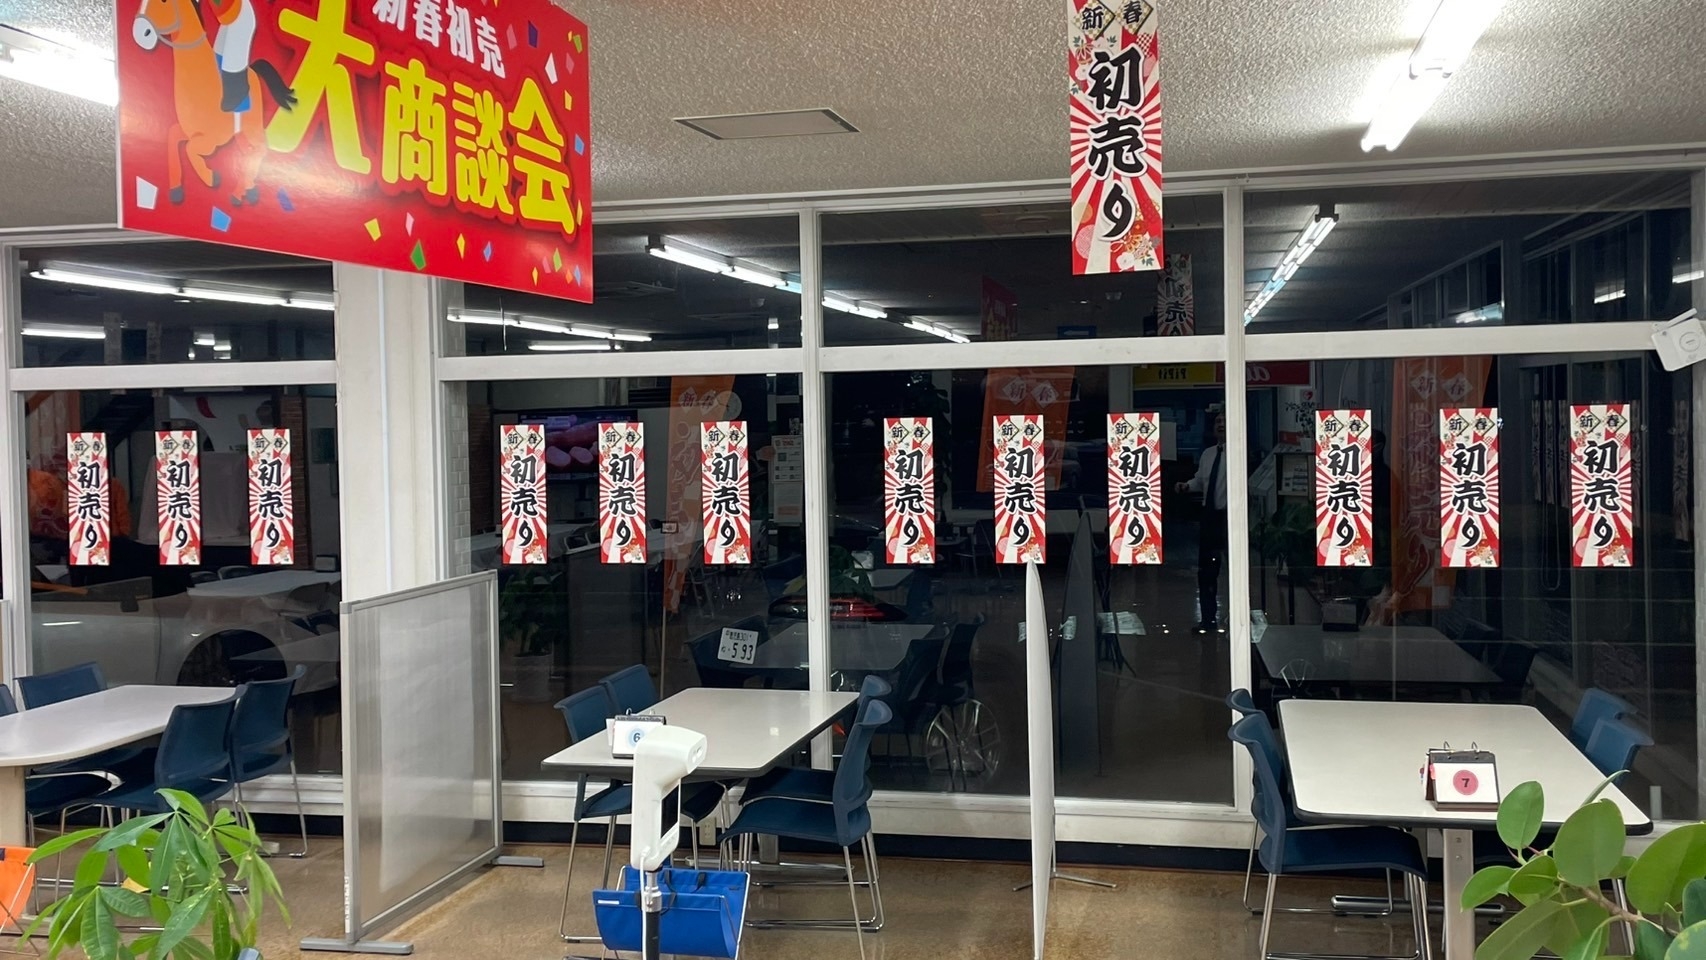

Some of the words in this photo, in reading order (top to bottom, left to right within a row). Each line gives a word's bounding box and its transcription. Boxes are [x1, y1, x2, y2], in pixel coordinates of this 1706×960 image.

[1081, 1, 1142, 30] 新春
[265, 0, 575, 235] 大商談会
[1088, 47, 1146, 238] 初売り
[605, 430, 636, 444] 新春
[708, 429, 740, 443] 新春
[892, 423, 925, 438] 新春
[1001, 425, 1036, 438] 新春
[1115, 422, 1151, 435] 新春
[1324, 418, 1361, 432] 新春
[1449, 417, 1488, 431] 新春
[1579, 415, 1621, 430] 新春
[73, 440, 102, 452] 新春
[163, 438, 192, 450] 新春
[255, 437, 284, 450] 新春
[507, 431, 538, 445] 新春
[77, 461, 102, 549] 初売り
[167, 460, 192, 548] 初売り
[258, 458, 284, 548] 初売り
[510, 455, 538, 547] 初売り
[608, 453, 636, 546] 初売り
[711, 453, 741, 546] 初売り
[894, 450, 925, 546] 初売り
[1004, 448, 1036, 545] 初売り
[1118, 447, 1151, 546] 初売り
[1327, 446, 1362, 547] 初売り
[1452, 445, 1487, 548] 初売り
[1583, 443, 1620, 547] 初売り
[633, 732, 641, 743] 6
[1461, 778, 1470, 788] 7
